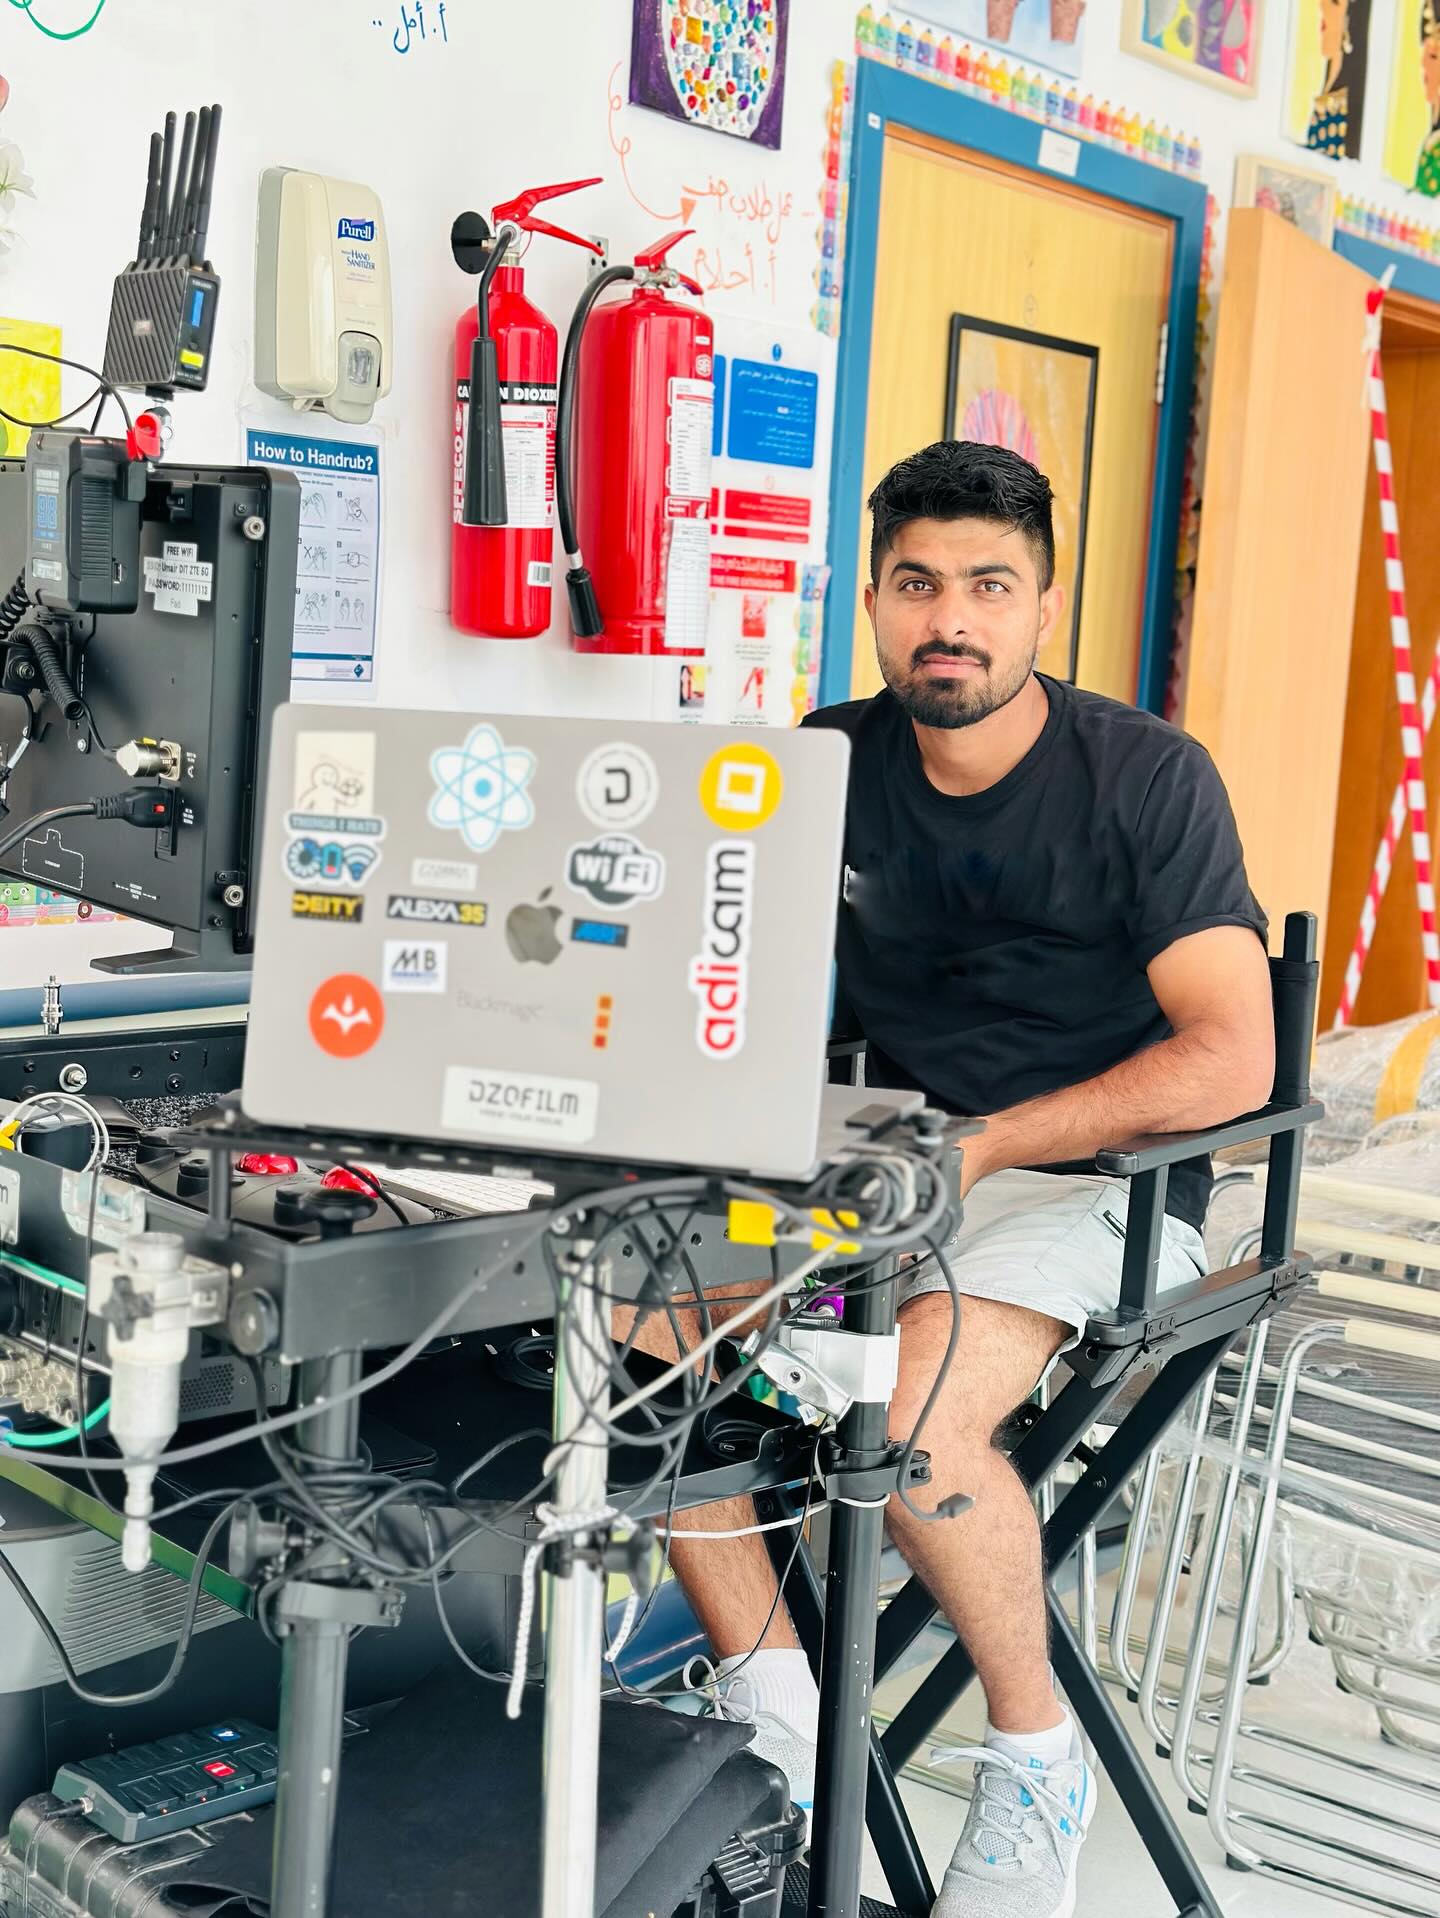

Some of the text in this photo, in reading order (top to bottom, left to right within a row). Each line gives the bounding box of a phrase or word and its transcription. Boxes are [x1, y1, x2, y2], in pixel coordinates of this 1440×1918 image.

[341, 219, 372, 240] Purell
[346, 257, 376, 270] SANITIZER
[254, 441, 374, 471] How to Handrub?
[166, 545, 179, 556] FREE
[696, 847, 746, 1051] adicam
[468, 1079, 580, 1116] DZOFILM
